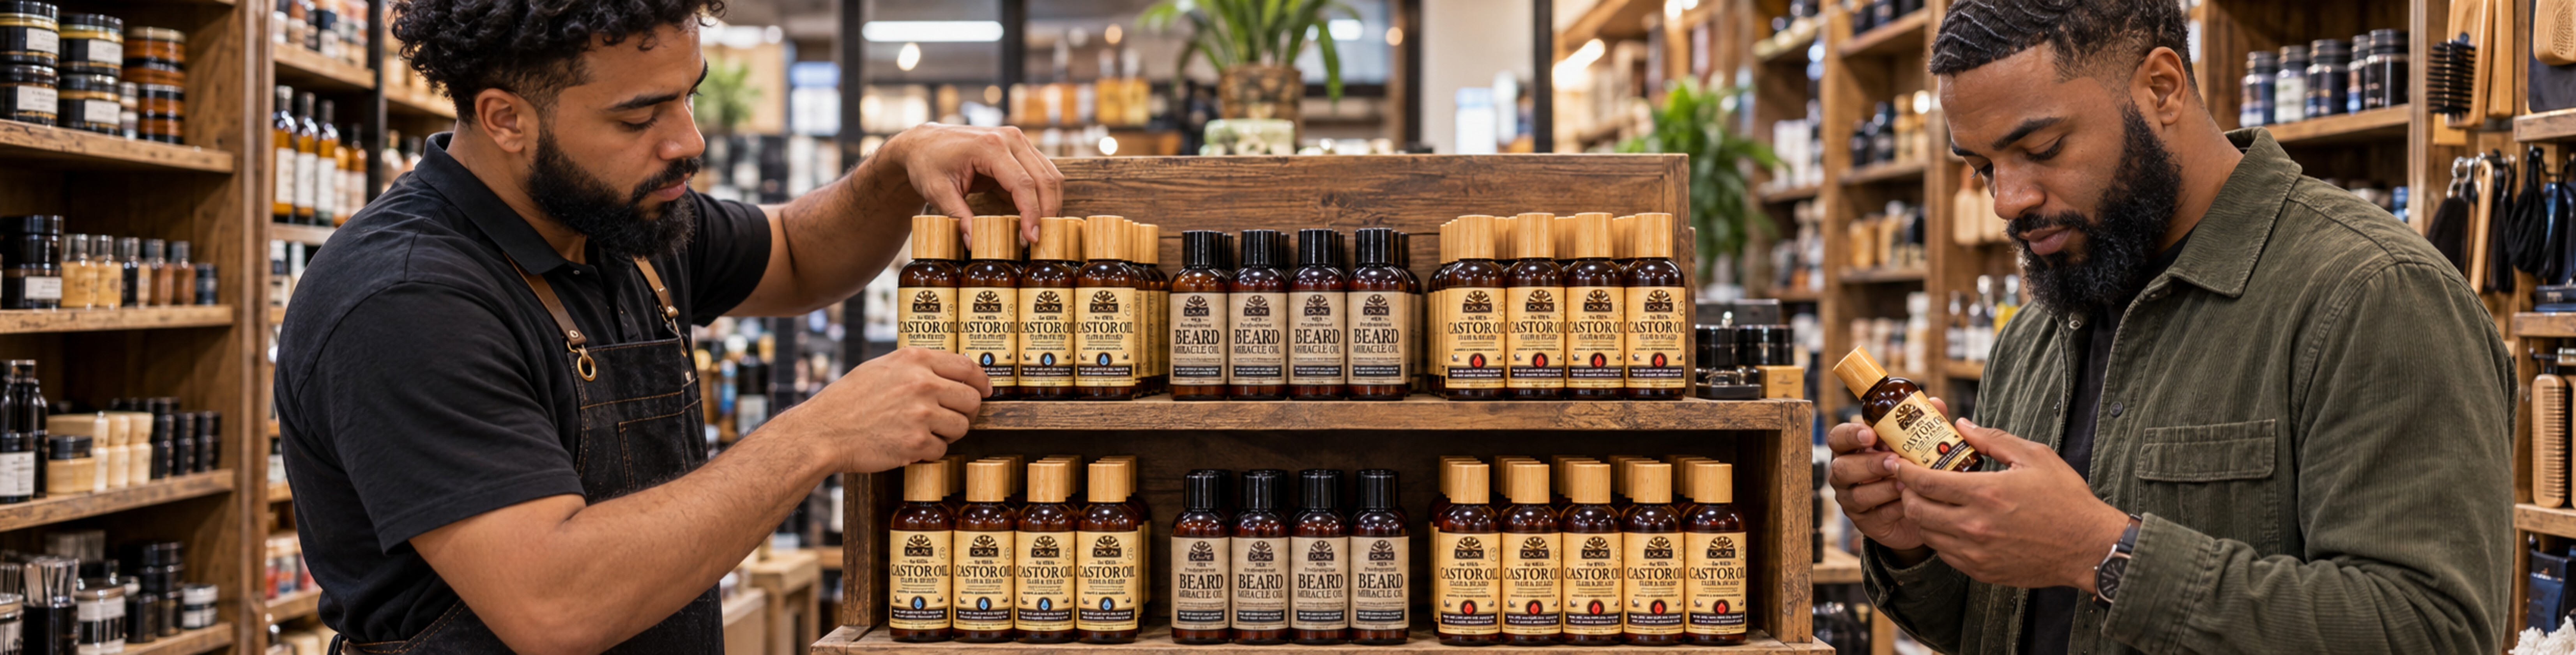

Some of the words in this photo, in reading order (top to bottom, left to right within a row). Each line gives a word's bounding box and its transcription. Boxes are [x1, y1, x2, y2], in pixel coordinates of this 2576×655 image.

[900, 321, 942, 333] CASTOR
[960, 321, 1002, 333] CASTOR
[1020, 321, 1063, 333] CASTOR
[1077, 321, 1119, 333] CASTOR
[1120, 322, 1133, 333] OIL
[1448, 321, 1491, 334] CASTOR
[1510, 321, 1553, 334] CASTOR
[1568, 321, 1611, 334] CASTOR
[1628, 321, 1672, 334] CASTOR
[1175, 329, 1220, 344] BEARD
[1235, 329, 1280, 344] BEARD
[1295, 329, 1340, 344] BEARD
[1354, 329, 1399, 344] BEARD
[1174, 345, 1207, 354] MIRACLE
[1209, 346, 1220, 354] OIL
[1234, 345, 1267, 354] MIRACLE
[1269, 346, 1280, 354] OIL
[891, 565, 932, 577] CASTOR
[934, 565, 948, 577] OIL
[956, 565, 998, 578] CASTOR
[1017, 565, 1059, 578] CASTOR
[1078, 565, 1121, 578] CASTOR
[1441, 567, 1483, 580] CASTOR
[1485, 568, 1498, 580] OIL
[1505, 568, 1549, 580] CASTOR
[1565, 567, 1609, 580] CASTOR
[1627, 567, 1672, 580] CASTOR
[1689, 567, 1734, 580] CASTOR
[1179, 574, 1223, 589] BEARD
[1239, 574, 1283, 590] BEARD
[1298, 574, 1343, 589] BEARD
[1358, 573, 1403, 589] BEARD
